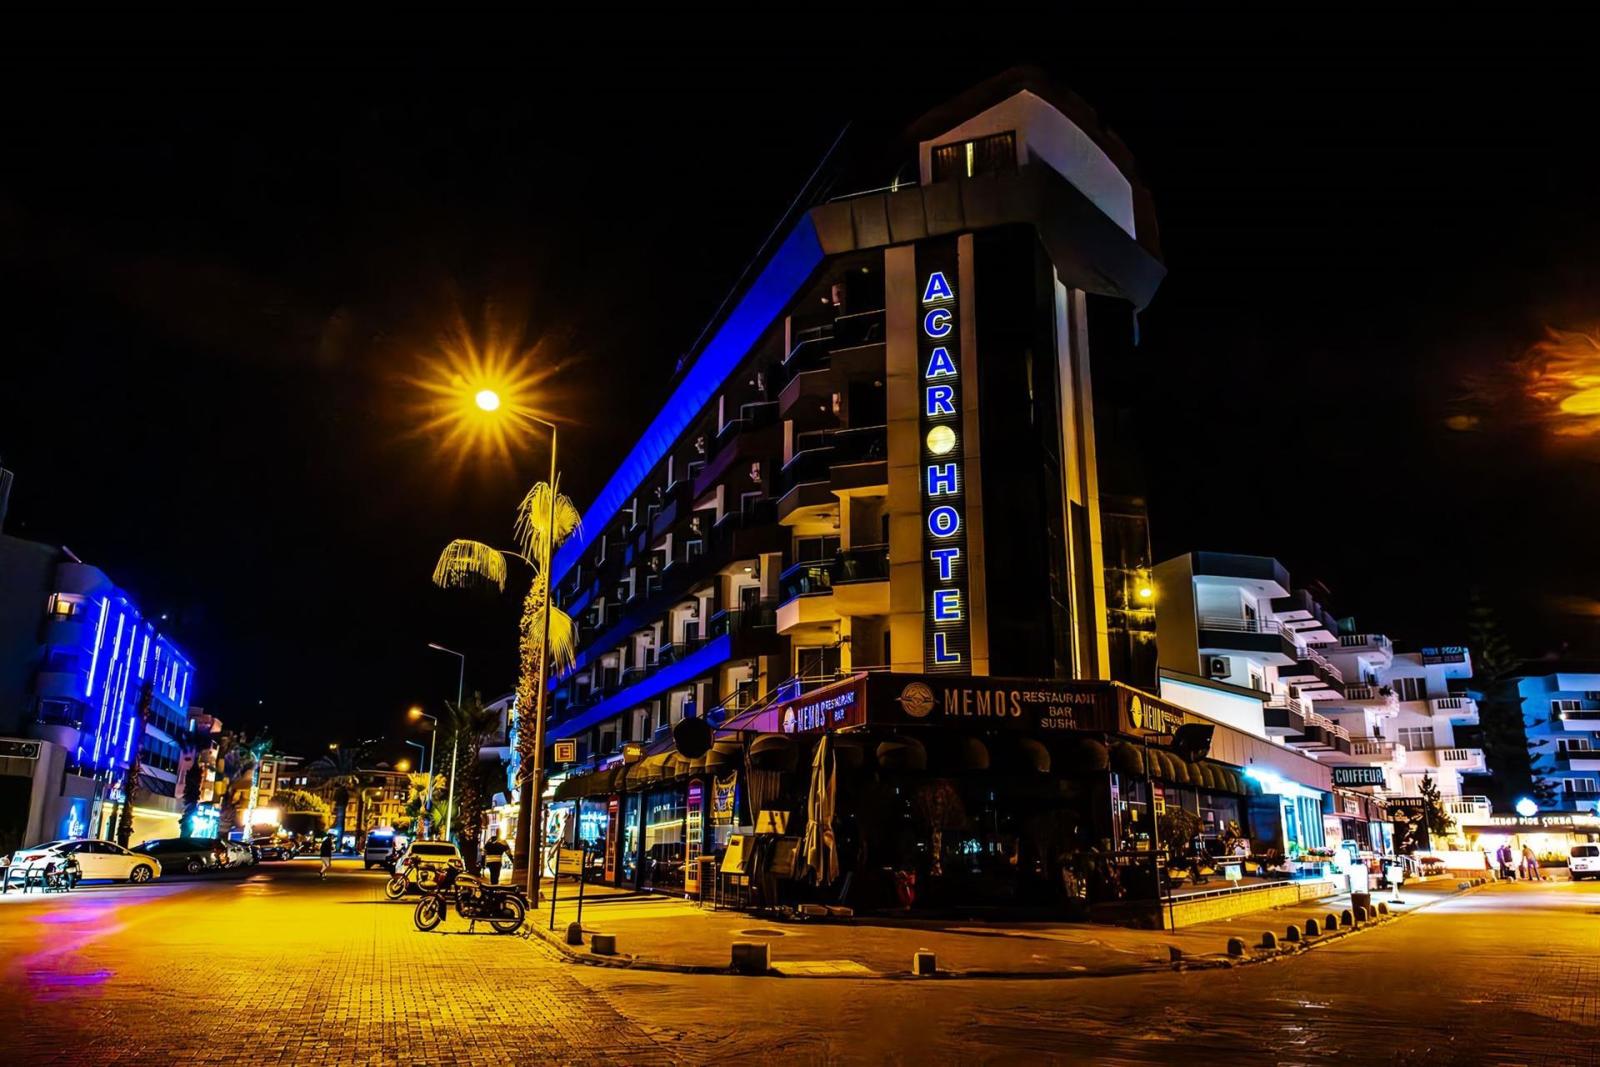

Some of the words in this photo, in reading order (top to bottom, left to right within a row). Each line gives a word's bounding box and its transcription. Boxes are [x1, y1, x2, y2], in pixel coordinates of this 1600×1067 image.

[922, 271, 957, 416] ACAR
[926, 462, 962, 665] HOTEL
[944, 688, 1022, 717] MEMOS
[1022, 691, 1096, 704] RESTAURANT
[1048, 706, 1073, 717] BAR
[797, 702, 826, 733] MEMOS
[1041, 717, 1079, 729] SUSHI
[1143, 703, 1166, 733] MEMOS
[1335, 768, 1383, 783] COIFFEUR
